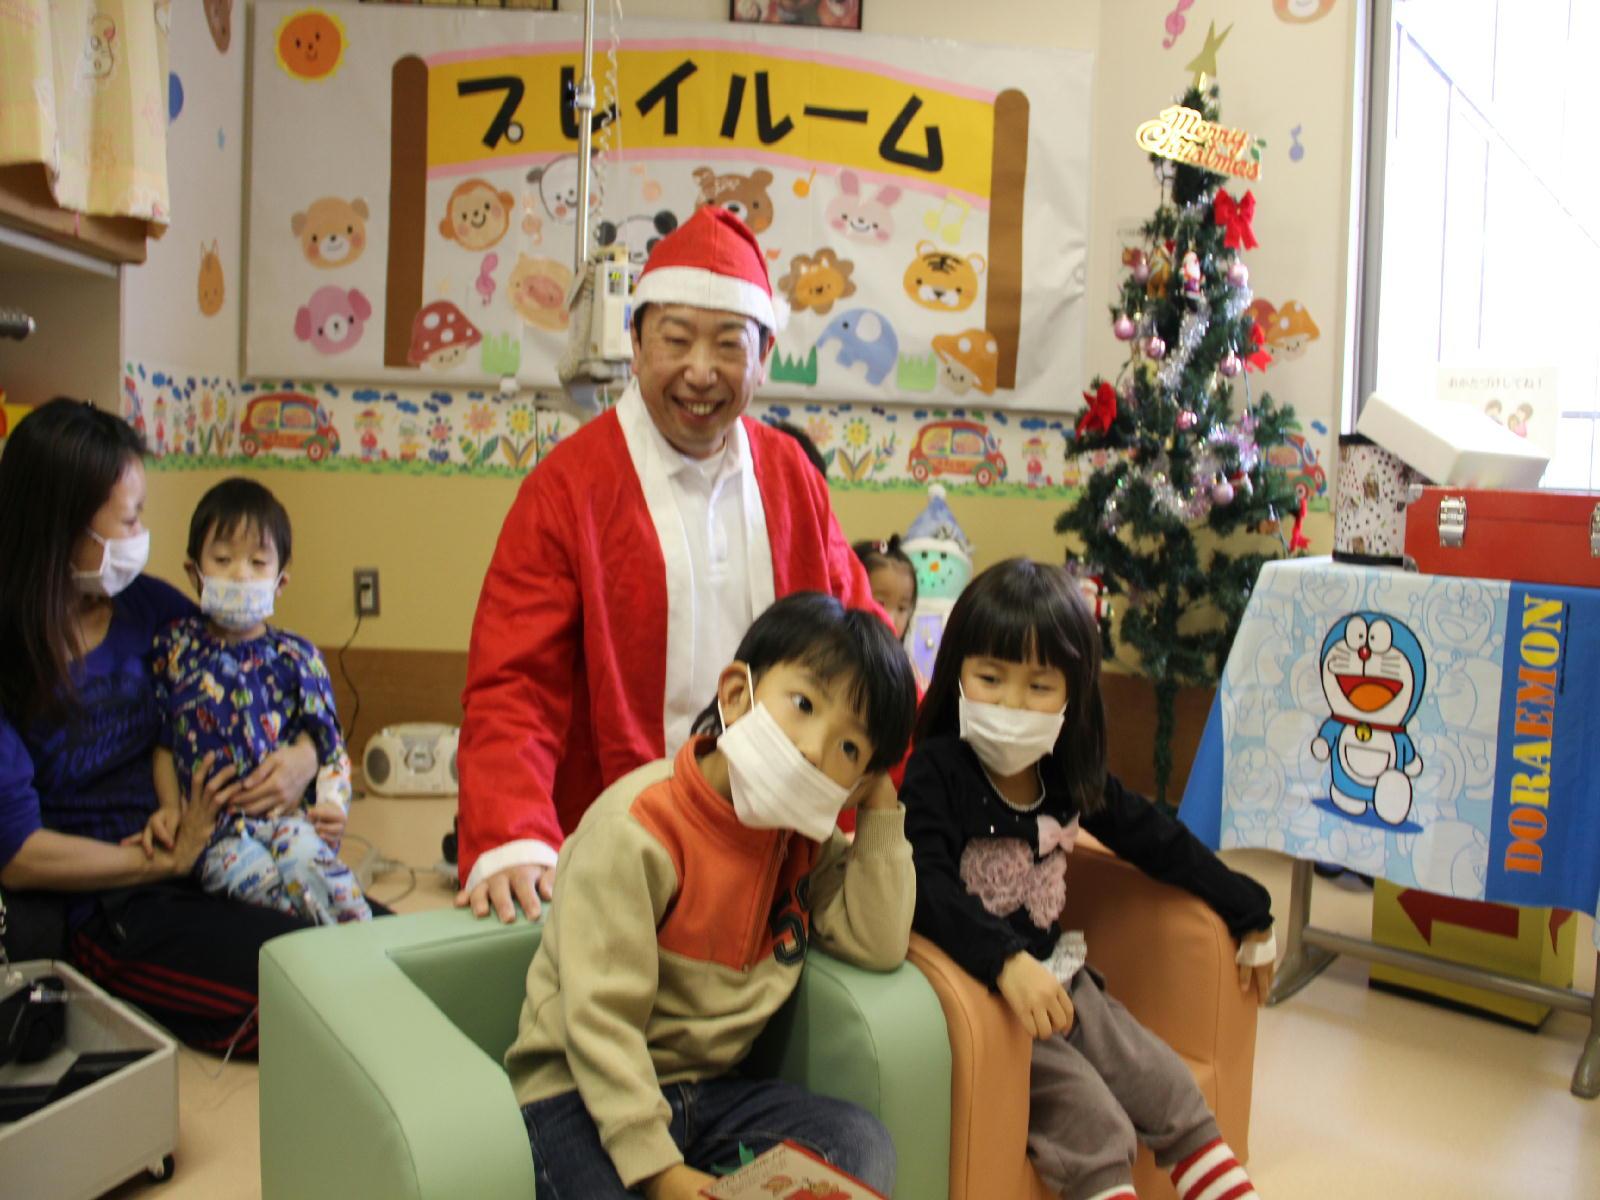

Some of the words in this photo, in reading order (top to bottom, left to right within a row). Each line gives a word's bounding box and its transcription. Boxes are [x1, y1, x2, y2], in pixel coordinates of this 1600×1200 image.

[456, 58, 945, 173] プレイルーム
[1136, 120, 1260, 182] Christmas
[1160, 106, 1248, 160] Merry
[1503, 591, 1563, 875] DORAEMON
